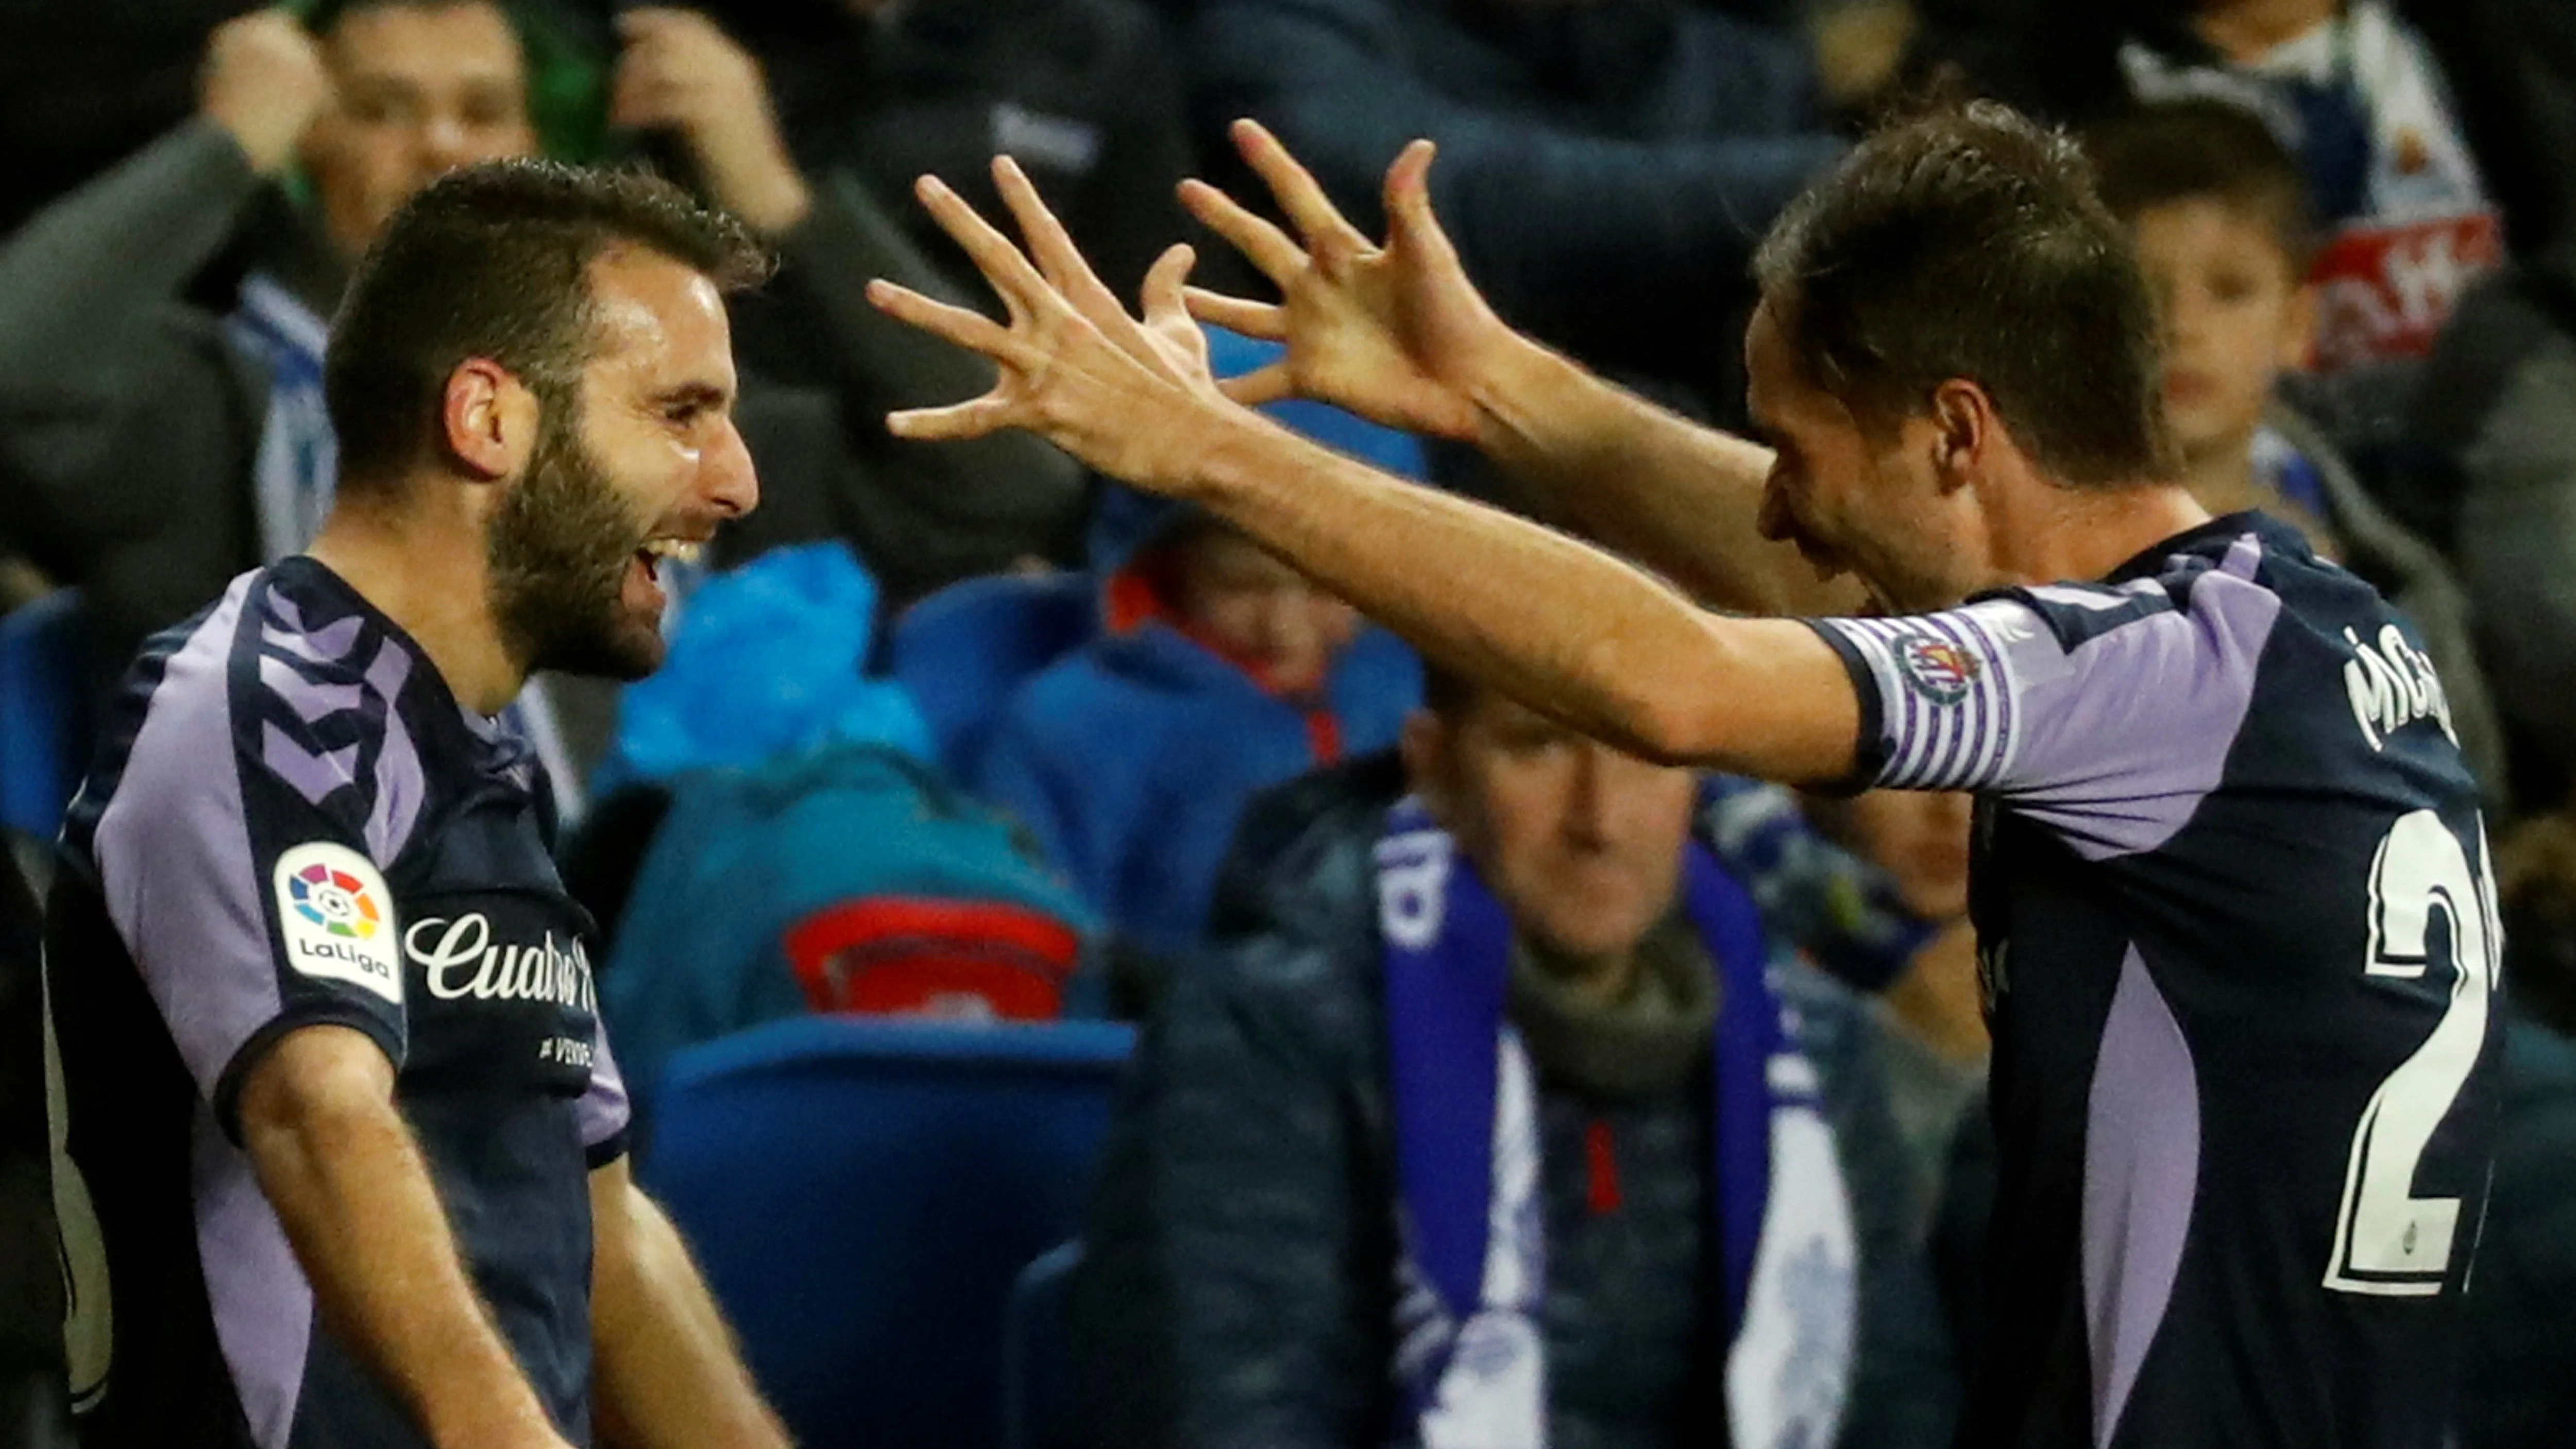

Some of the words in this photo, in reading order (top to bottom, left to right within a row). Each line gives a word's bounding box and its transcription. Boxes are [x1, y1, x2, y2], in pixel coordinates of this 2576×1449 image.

[299, 937, 391, 979] LaLiga
[405, 912, 577, 1006] Cuatro
[2323, 808, 2505, 1295] 2
